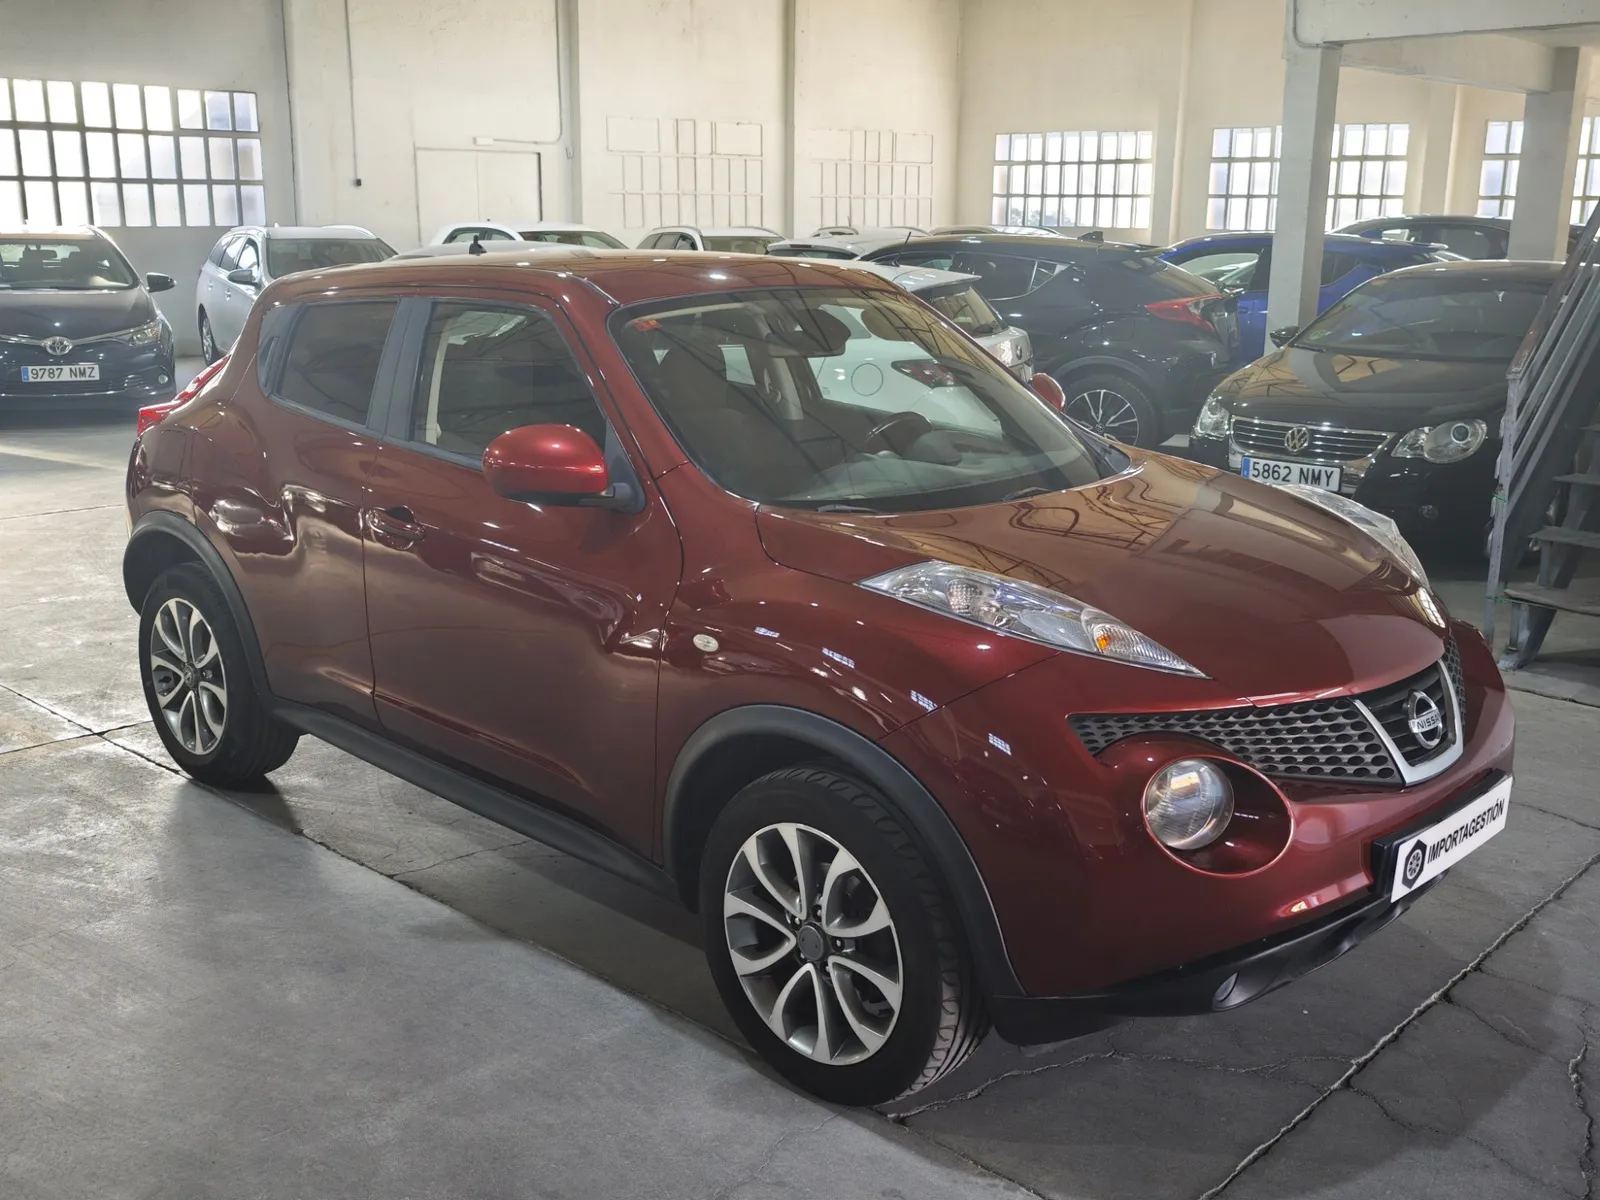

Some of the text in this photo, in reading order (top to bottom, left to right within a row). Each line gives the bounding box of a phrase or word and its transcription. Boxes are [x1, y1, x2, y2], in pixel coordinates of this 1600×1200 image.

[30, 366, 96, 380] 9787 NMZ
[1252, 461, 1334, 487] 5862 NMY
[1427, 798, 1505, 865] IMPORTAGESTIÓN
